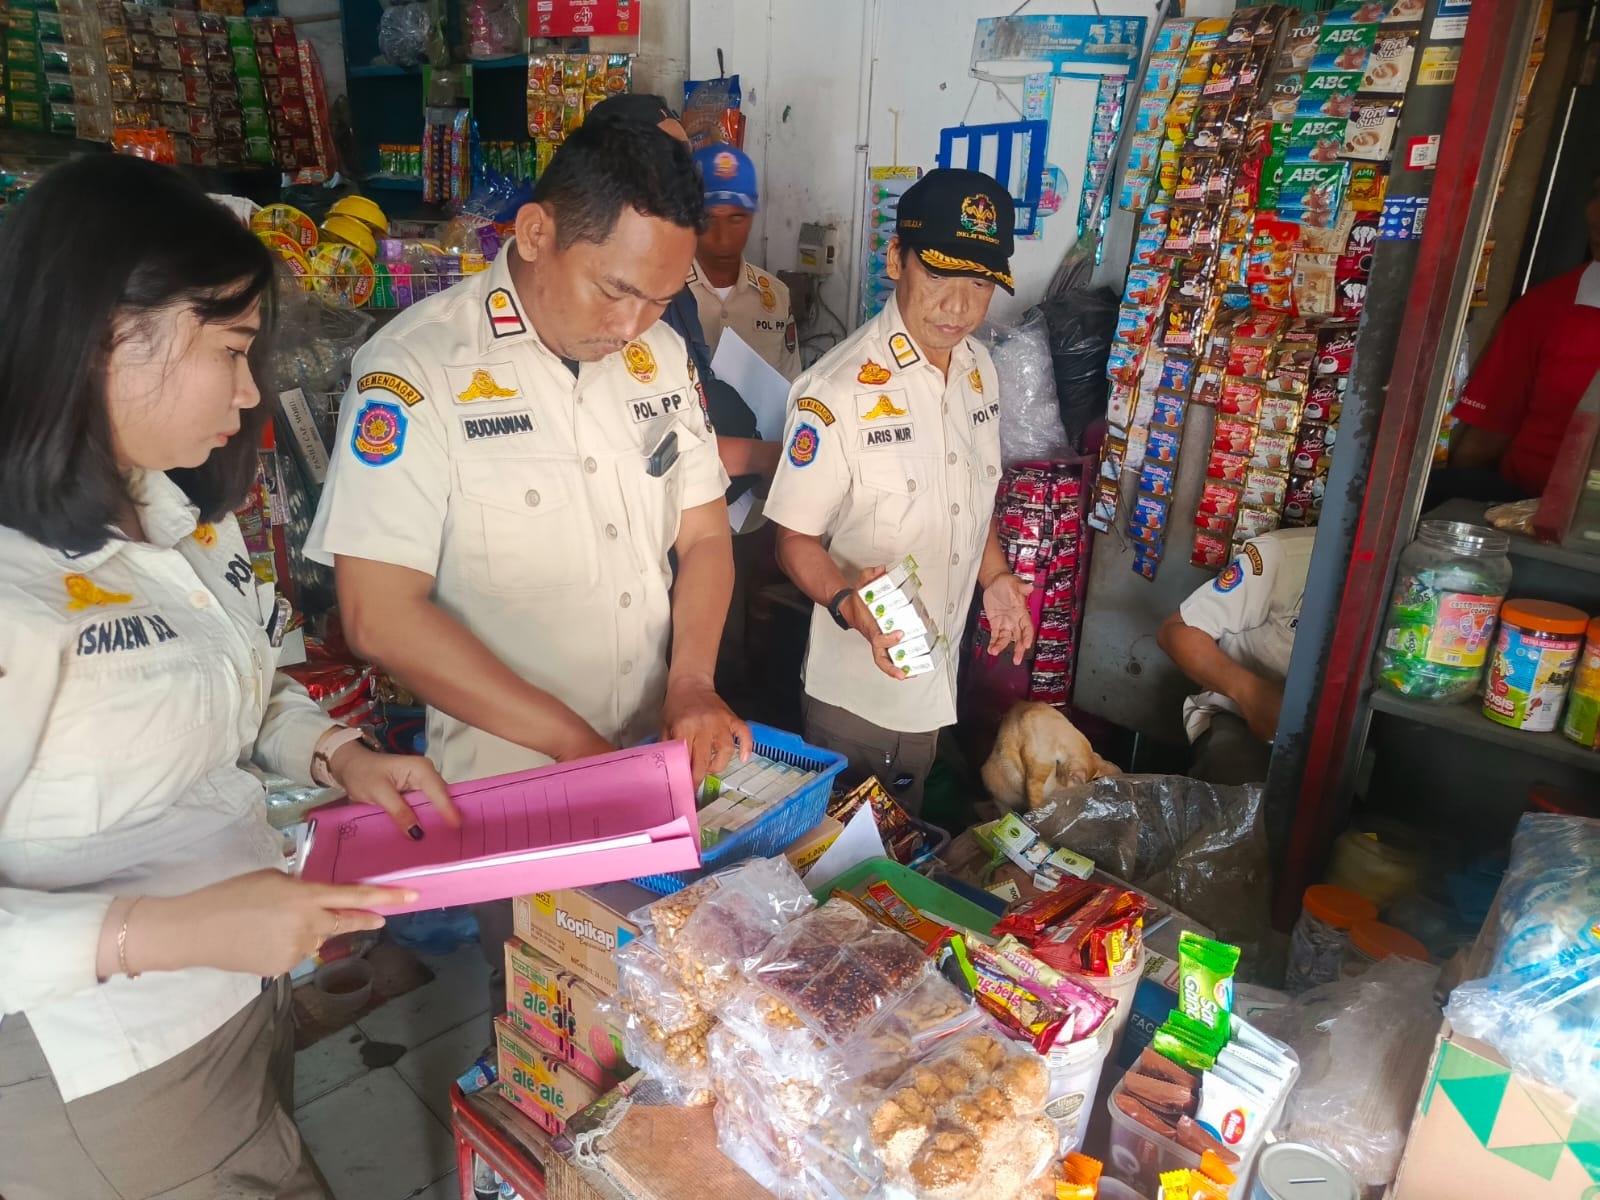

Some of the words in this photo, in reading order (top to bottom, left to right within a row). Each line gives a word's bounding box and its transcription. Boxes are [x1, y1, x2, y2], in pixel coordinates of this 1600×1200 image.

[1292, 25, 1319, 38] TOP
[1324, 28, 1367, 42] ABC
[1310, 76, 1352, 88] ABC
[1275, 84, 1302, 95] TOP
[1298, 122, 1340, 136] ABC
[1289, 168, 1330, 182] ABC
[756, 320, 773, 330] POL
[776, 322, 784, 330] PP
[360, 375, 418, 403] KEMENDAGRI
[634, 400, 656, 420] POL
[662, 394, 682, 412] PP
[990, 403, 999, 417] PP
[464, 414, 532, 440] BUDIAWAN
[866, 429, 892, 446] ARIS
[896, 427, 912, 443] NUR
[556, 908, 616, 951] Kopikap
[1002, 950, 1040, 979] SPECIAL
